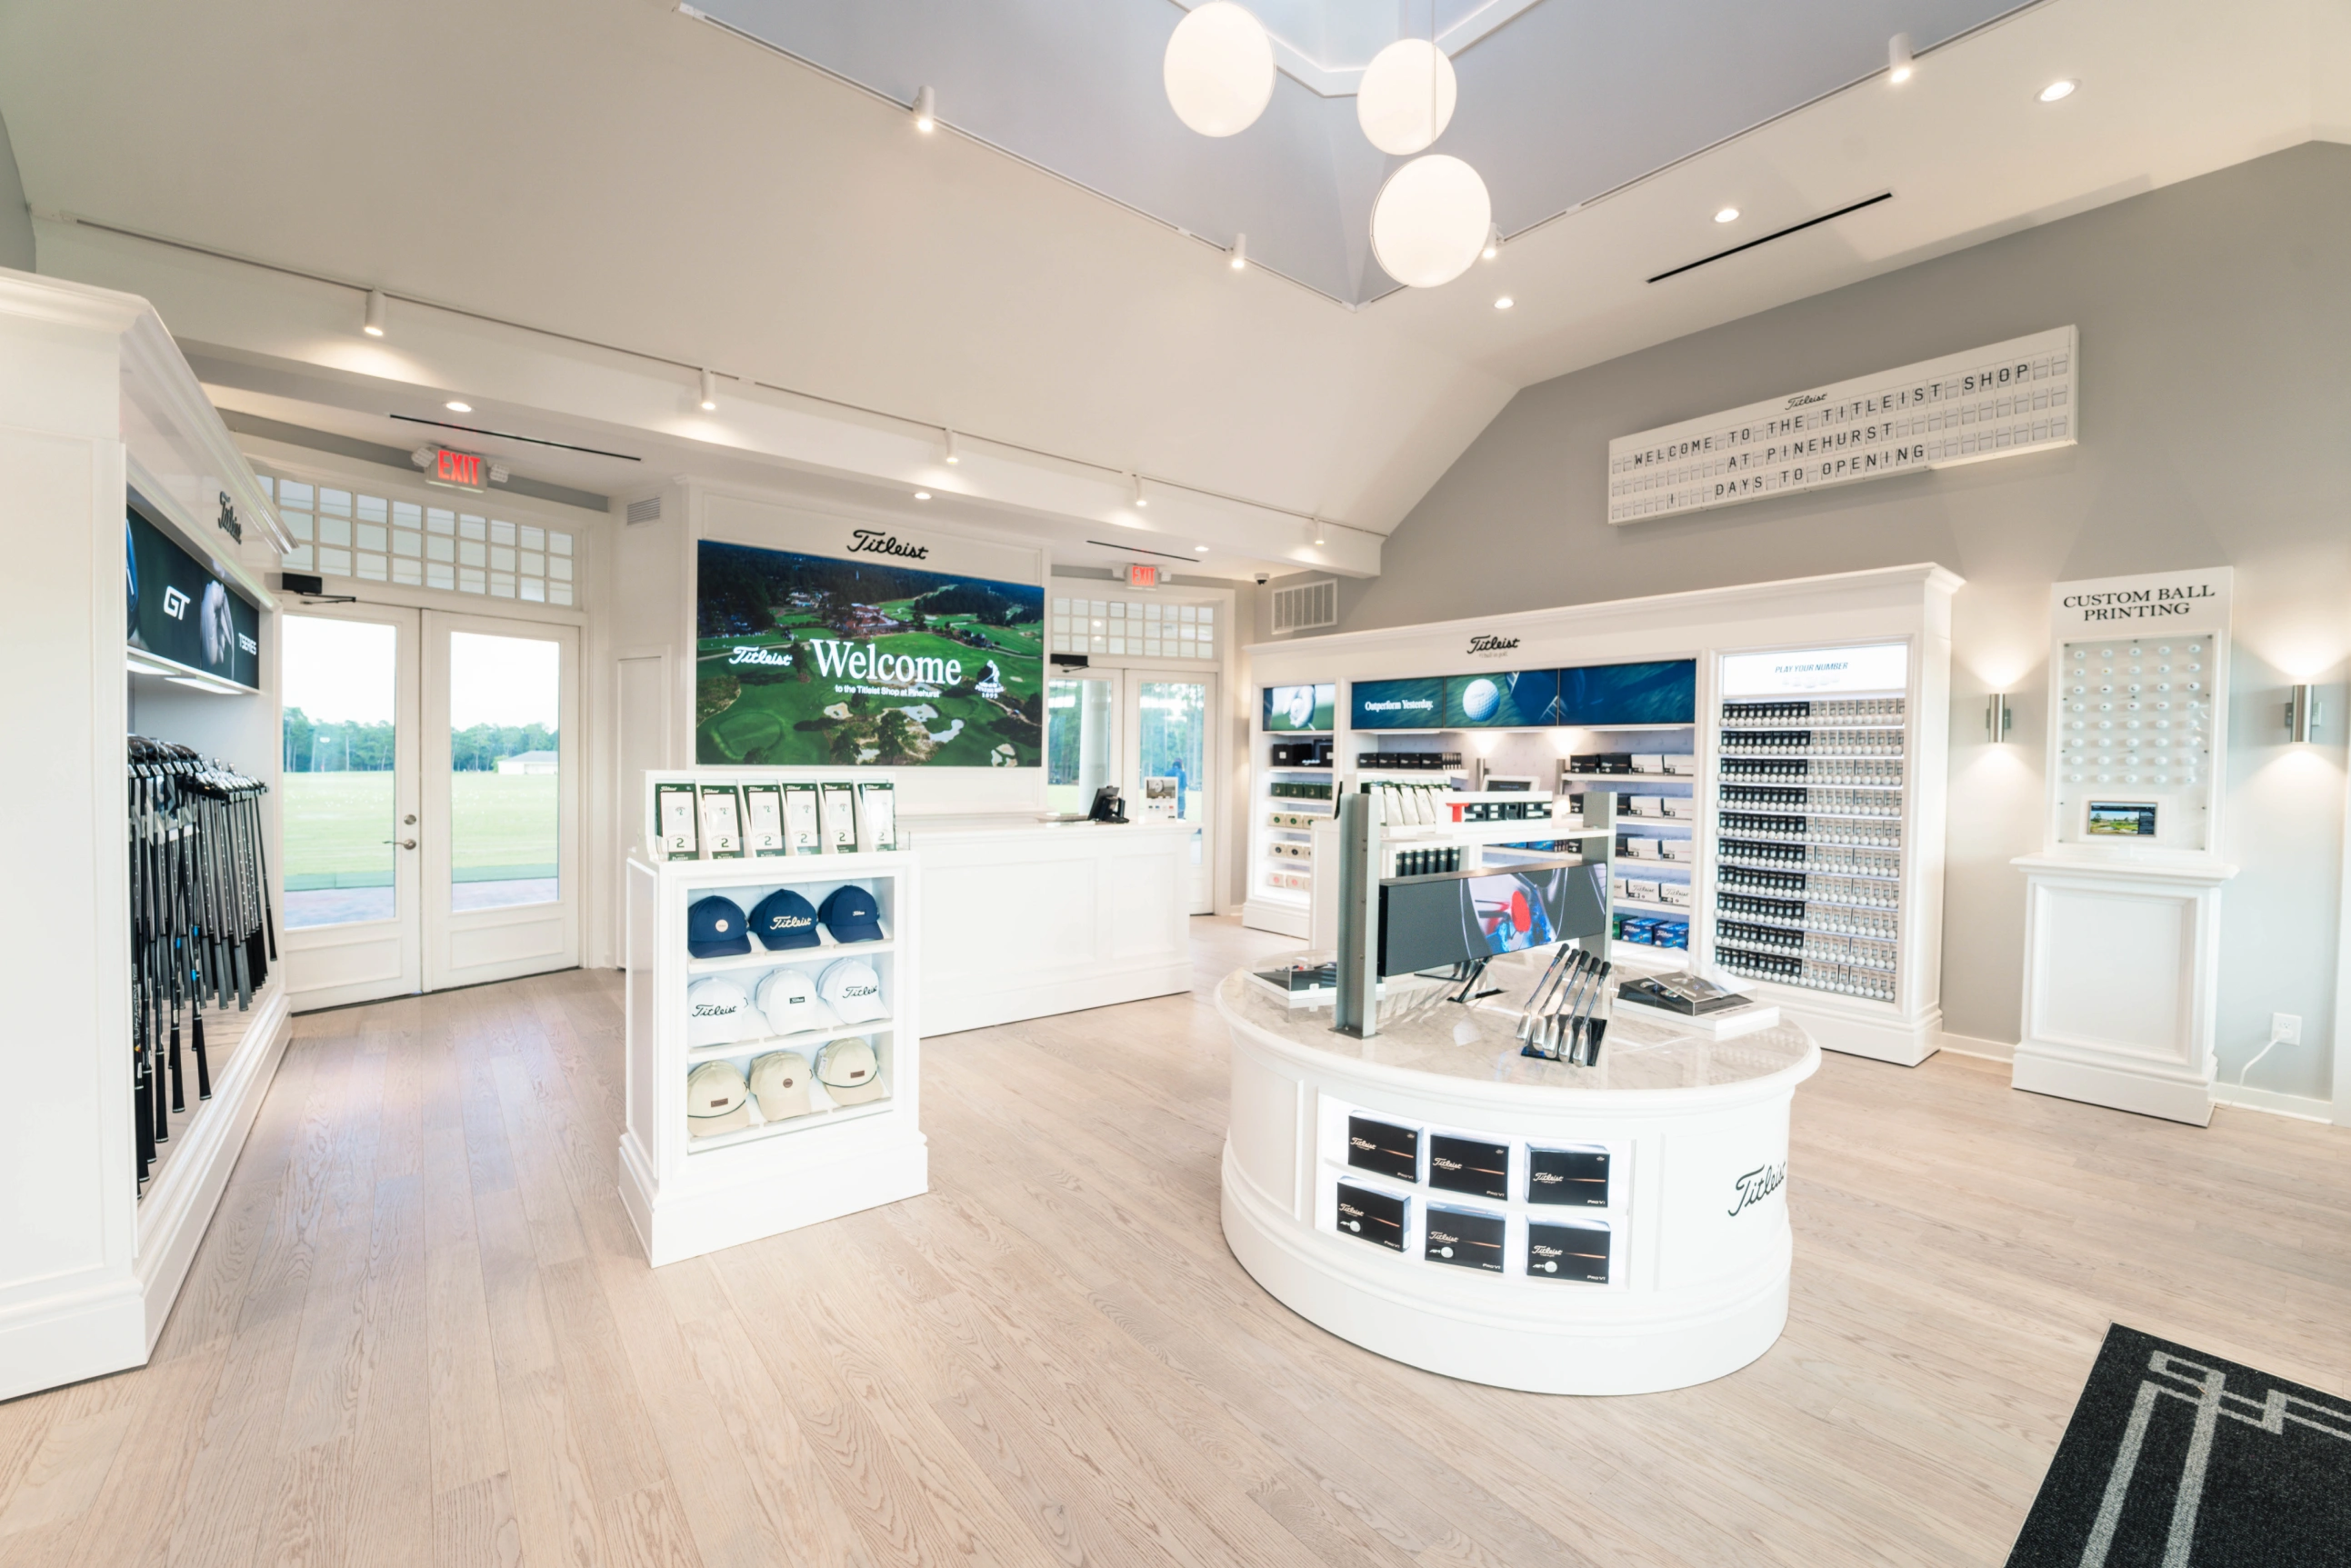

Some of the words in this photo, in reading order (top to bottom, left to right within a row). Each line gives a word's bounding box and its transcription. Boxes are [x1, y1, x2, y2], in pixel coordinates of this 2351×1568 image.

[1785, 393, 1827, 410] Titleist
[1635, 436, 1713, 464] WELCOME
[1729, 428, 1750, 443] TO
[1768, 415, 1804, 434] THE
[1823, 384, 1941, 422] TITLEIST
[1965, 365, 2028, 391] SHOP
[1729, 453, 1749, 467] AT
[1767, 423, 1892, 460] PINEHURST
[438, 450, 481, 485] EXIT
[1716, 476, 1762, 495] DAYS
[1781, 468, 1803, 483] TO
[1822, 444, 1924, 475] OPENING
[846, 529, 929, 560] Titleist
[1132, 566, 1155, 586] EXIT
[164, 585, 191, 620] GT
[2063, 590, 2151, 608] CUSTOM
[2157, 584, 2216, 601] BALL
[2083, 602, 2190, 621] PRINTING
[1466, 634, 1520, 654] Titleist
[729, 645, 793, 667] Titleist
[809, 638, 962, 686] Welcome
[1775, 665, 1794, 674] PLAY
[1795, 664, 1814, 673] YOUR
[1815, 662, 1848, 671] NUMBER
[835, 684, 843, 693] to
[844, 685, 855, 694] the
[856, 685, 880, 695] Titleist
[881, 688, 899, 698] Shop
[908, 689, 940, 698] Pinehurst
[1365, 700, 1401, 713] Outperform
[1402, 698, 1434, 711] Yesterday.
[676, 837, 685, 848] 2
[721, 838, 729, 848] 2
[765, 835, 772, 846] 2
[800, 834, 807, 844] 2
[839, 832, 845, 842] 2
[770, 915, 812, 930] Titleist
[842, 985, 877, 998] Titleist
[692, 1004, 737, 1017] Titleist
[1350, 1136, 1376, 1150] Titleist
[1433, 1157, 1463, 1169] Titleist
[1533, 1172, 1564, 1182] Titleist
[1728, 1159, 1786, 1216] Titleist
[1338, 1203, 1364, 1216] Titleist
[1429, 1231, 1459, 1242] Titleist
[1532, 1244, 1563, 1255] Titleist
